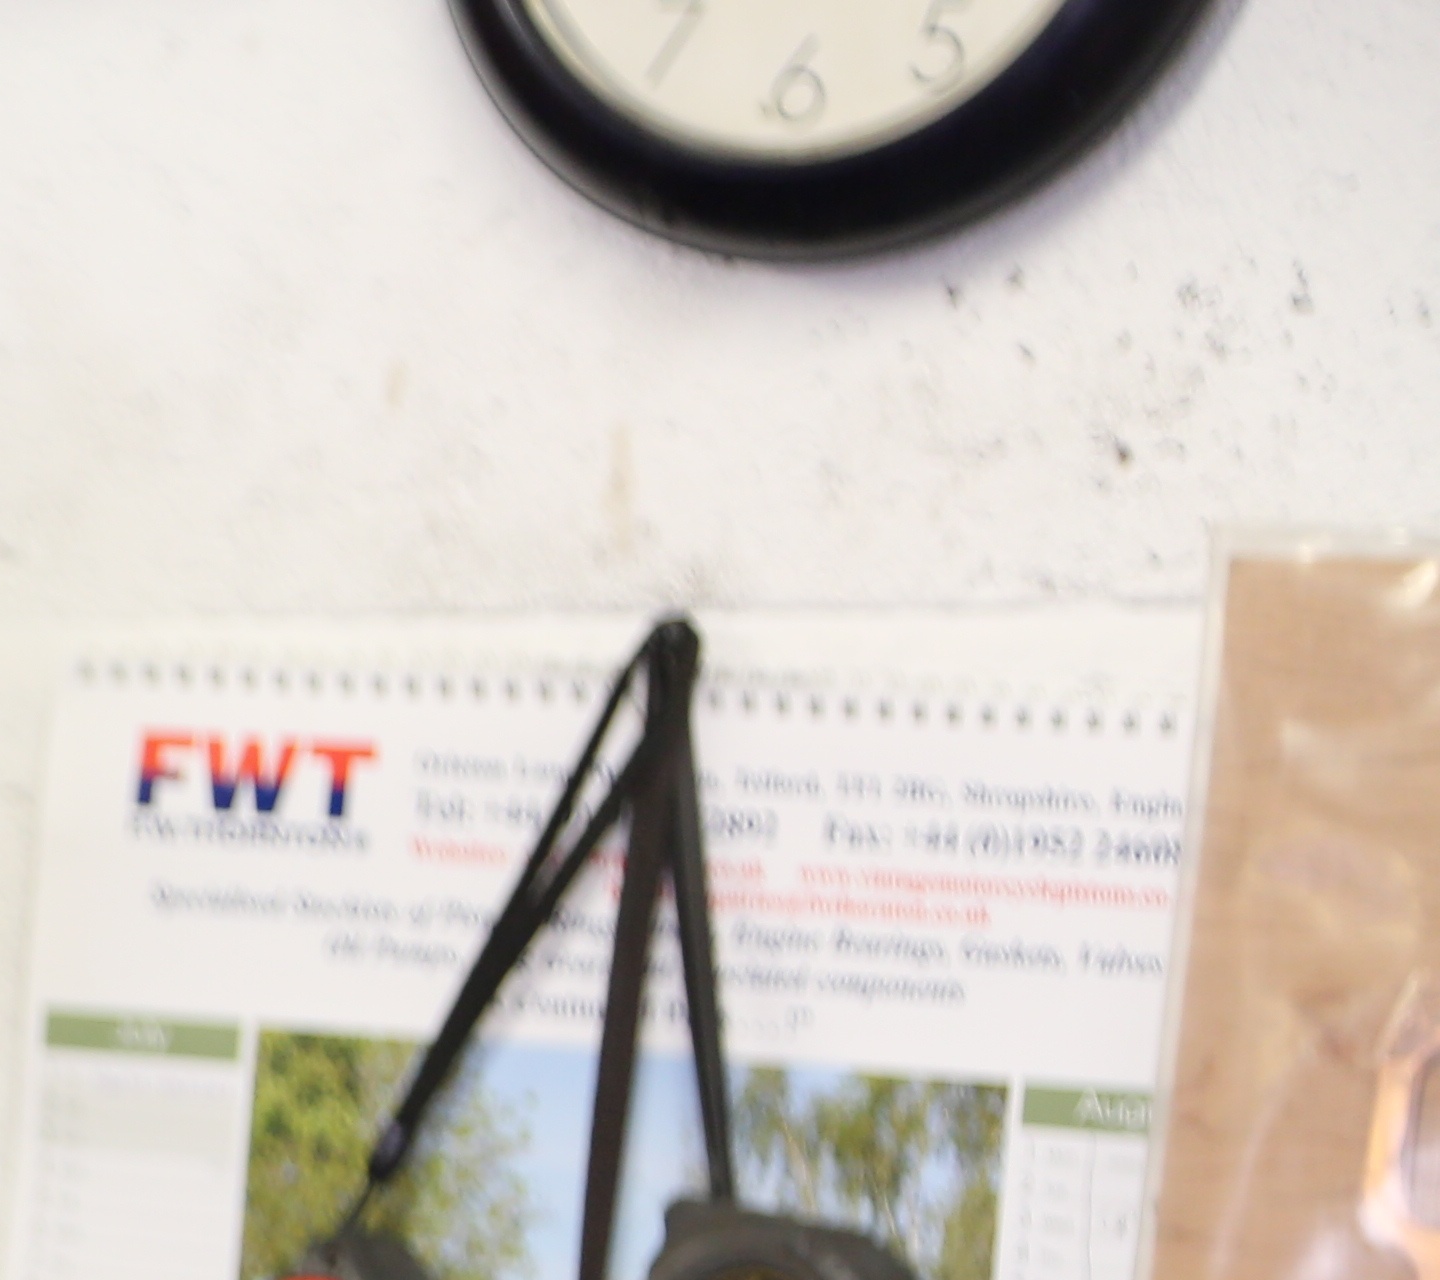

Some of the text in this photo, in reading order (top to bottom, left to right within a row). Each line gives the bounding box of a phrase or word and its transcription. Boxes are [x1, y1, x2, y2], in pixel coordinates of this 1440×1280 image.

[758, 30, 828, 125] 6
[908, 0, 968, 90] 5
[135, 728, 379, 818] FWT
